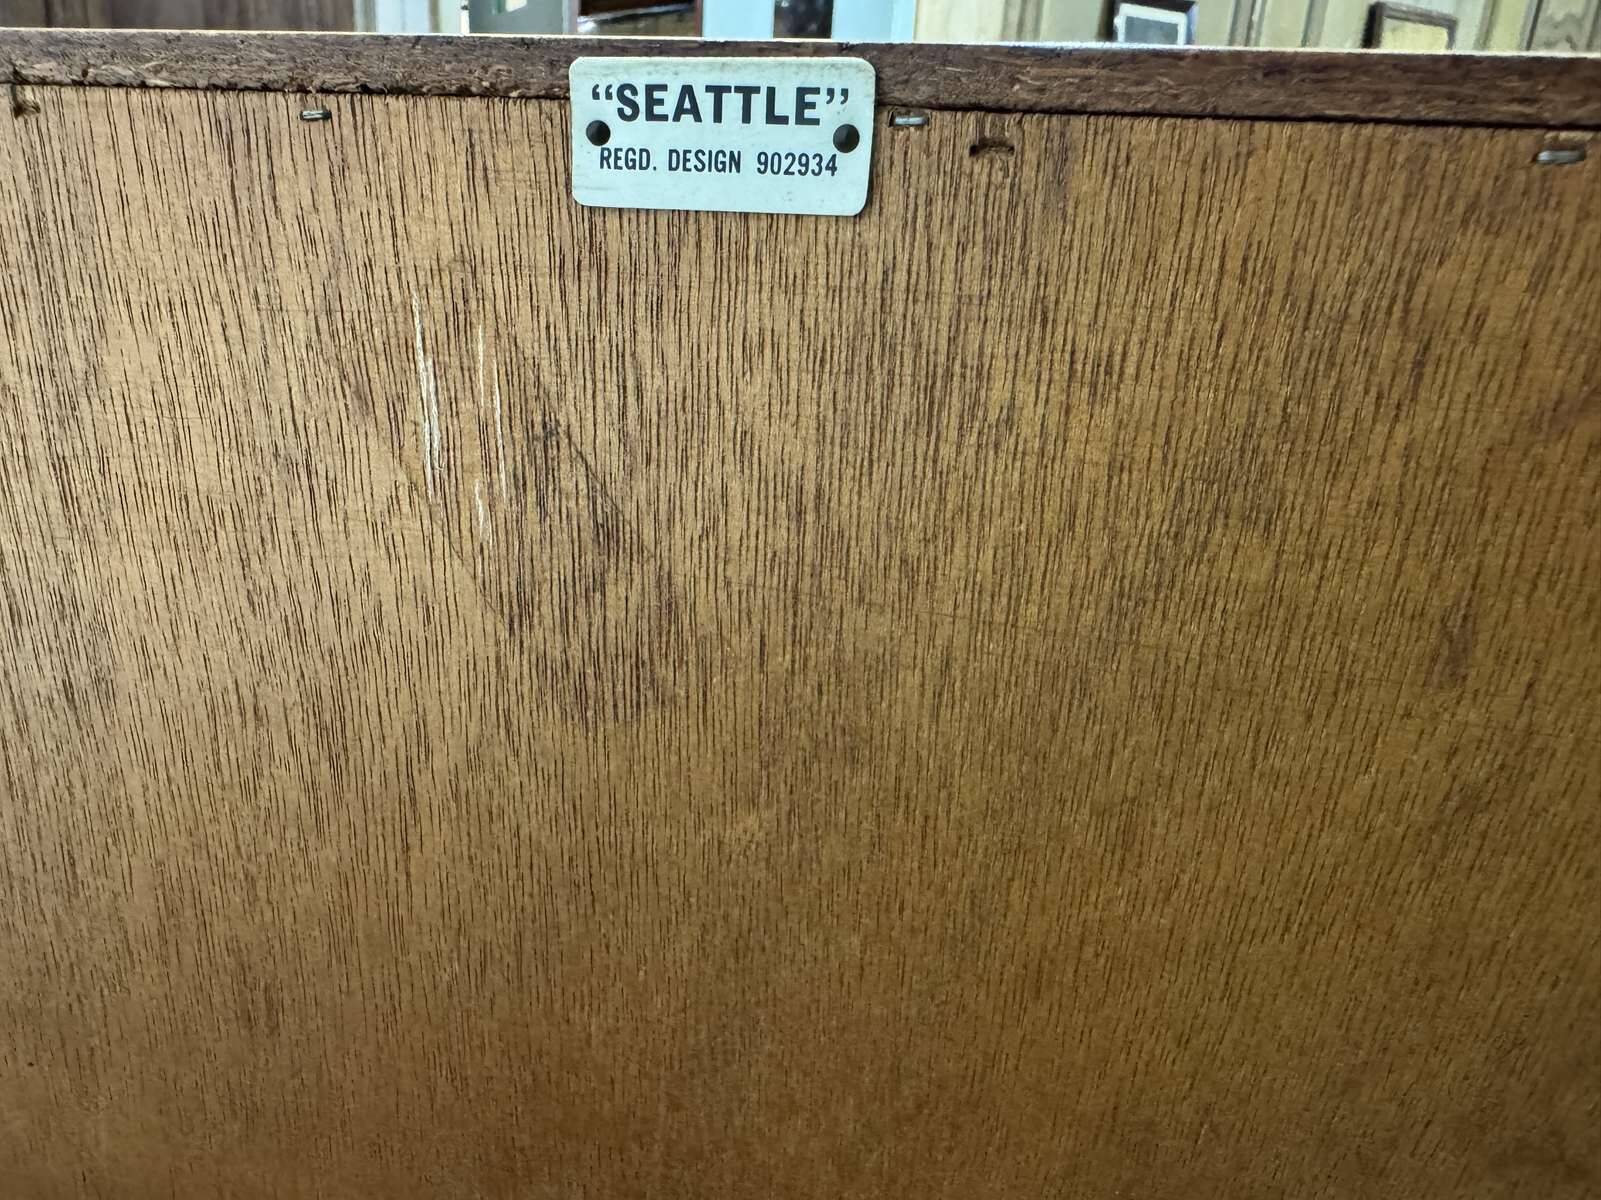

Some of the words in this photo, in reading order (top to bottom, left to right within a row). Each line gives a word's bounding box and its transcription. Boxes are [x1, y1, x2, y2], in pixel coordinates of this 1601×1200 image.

[599, 147, 657, 171] REGD.
[667, 148, 742, 174] DESIGN
[756, 151, 838, 177] 902934
